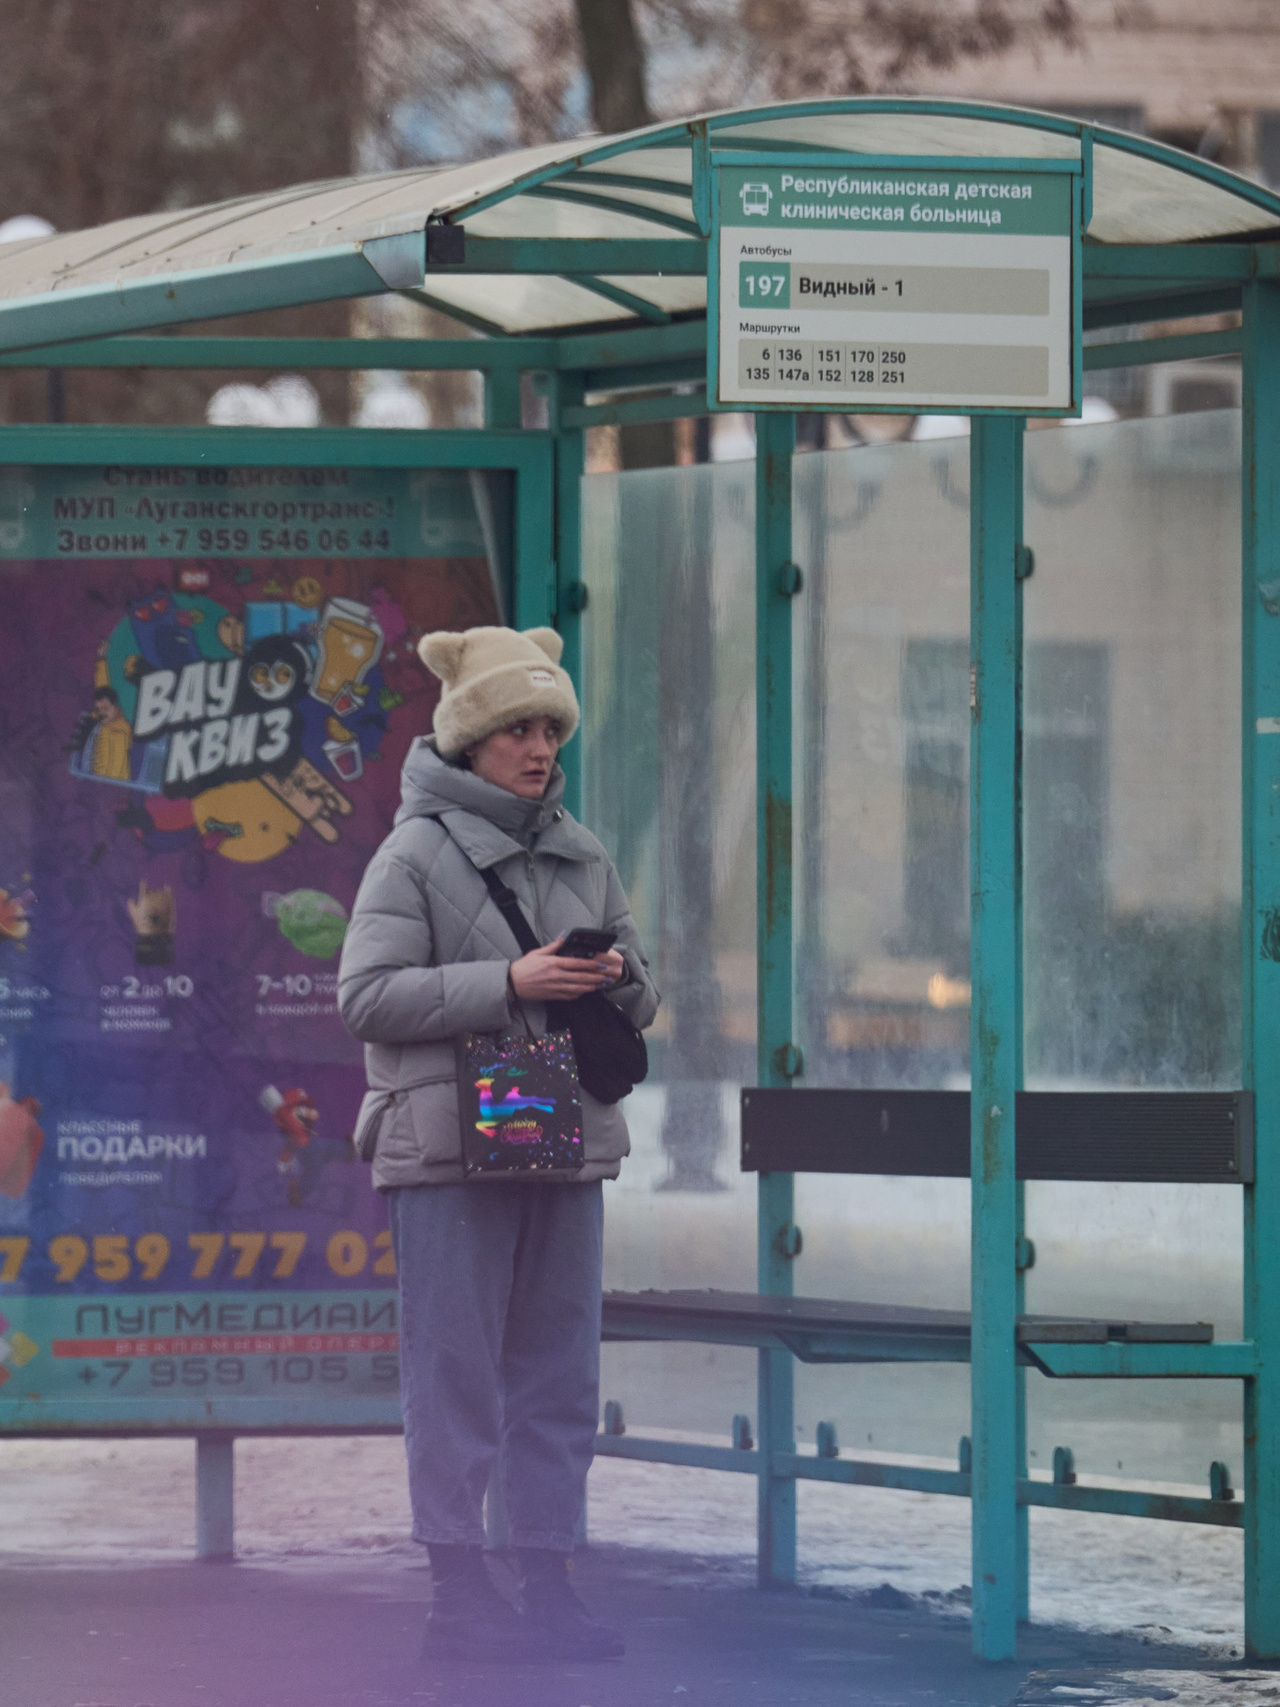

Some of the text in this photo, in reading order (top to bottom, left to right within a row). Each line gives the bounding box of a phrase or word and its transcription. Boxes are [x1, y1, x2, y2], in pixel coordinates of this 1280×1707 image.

[781, 174, 1033, 201] Республиканская детская
[780, 202, 1002, 227] клиническая больница
[740, 245, 792, 258] Автобусы
[745, 274, 786, 297] 197
[799, 277, 876, 298] Видный
[895, 279, 903, 297] 1
[739, 322, 801, 335] Маршрутки
[762, 348, 907, 364] 6 136 151 170 250
[746, 368, 770, 381] 135
[818, 370, 842, 382] 152
[850, 370, 875, 383] 128
[881, 371, 905, 384] 251
[53, 496, 115, 519] МУП
[56, 528, 390, 552] Звони +7 959 546 06 44
[134, 658, 242, 737] ВАУ
[165, 706, 293, 784] КВИЗ
[122, 975, 141, 999] 2
[163, 974, 194, 998] 10
[57, 1134, 208, 1164] ПОДАРКИ
[48, 1232, 170, 1283] 959
[187, 1231, 308, 1279] 777
[75, 1299, 397, 1335] ЛУГМЕДИАИ
[76, 1359, 131, 1388] +7
[149, 1356, 245, 1388] 959
[267, 1355, 349, 1385] 105
